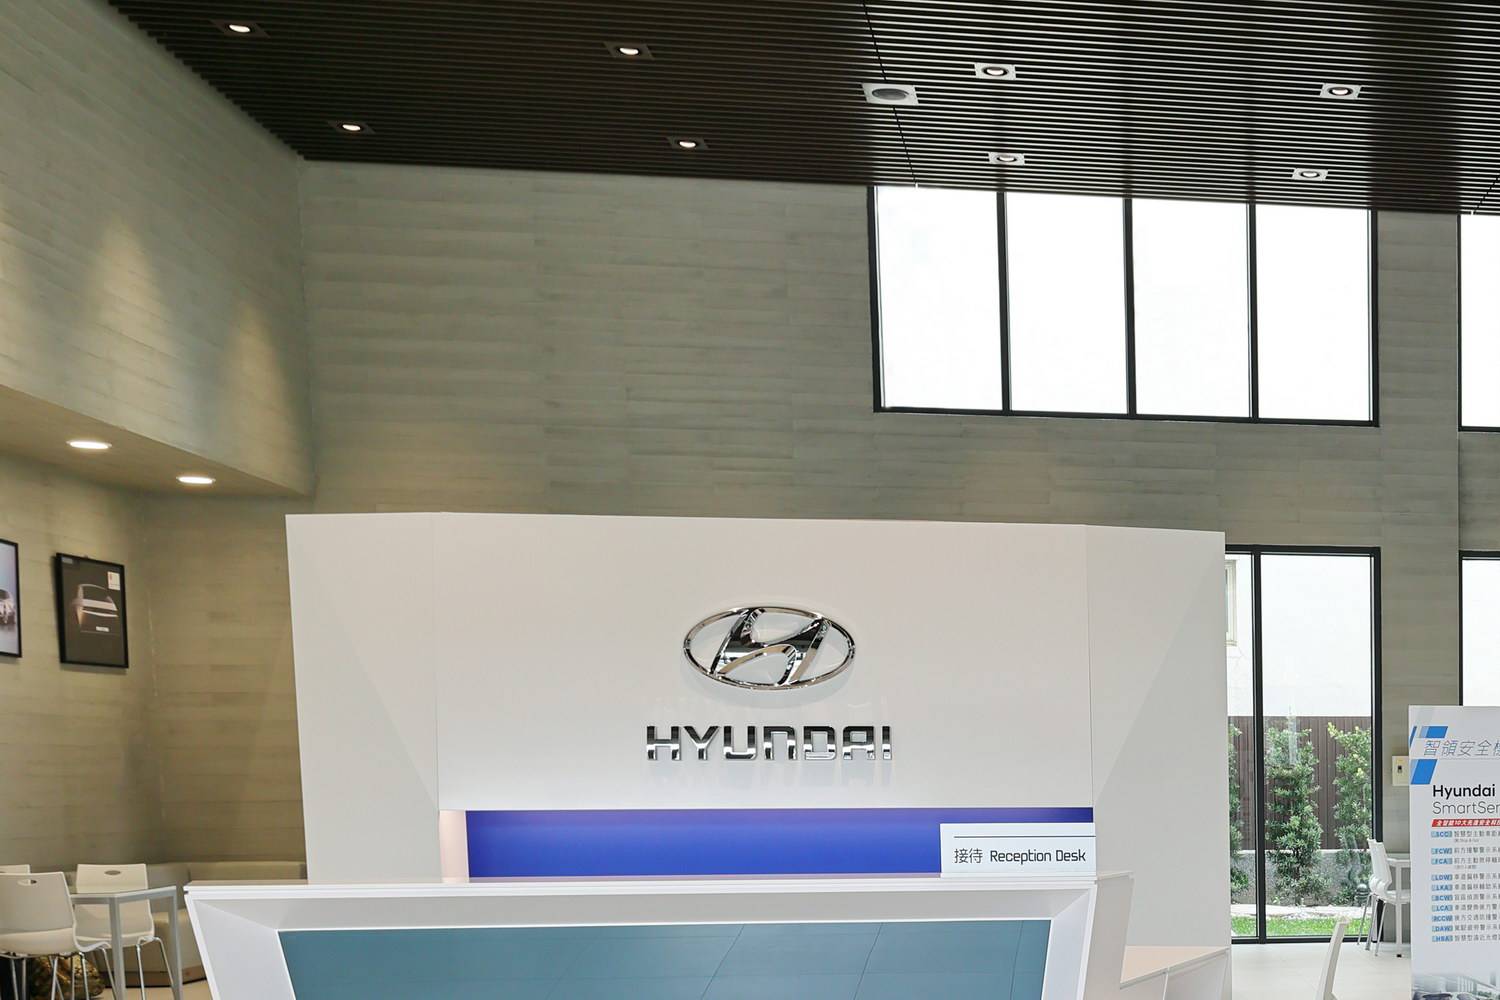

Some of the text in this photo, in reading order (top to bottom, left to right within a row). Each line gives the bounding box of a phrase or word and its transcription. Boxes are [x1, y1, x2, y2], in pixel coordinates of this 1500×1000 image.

[646, 725, 893, 761] HYUNDAI
[1432, 784, 1495, 800] Hyundai
[954, 848, 1086, 865] 接待 Reception Desk
